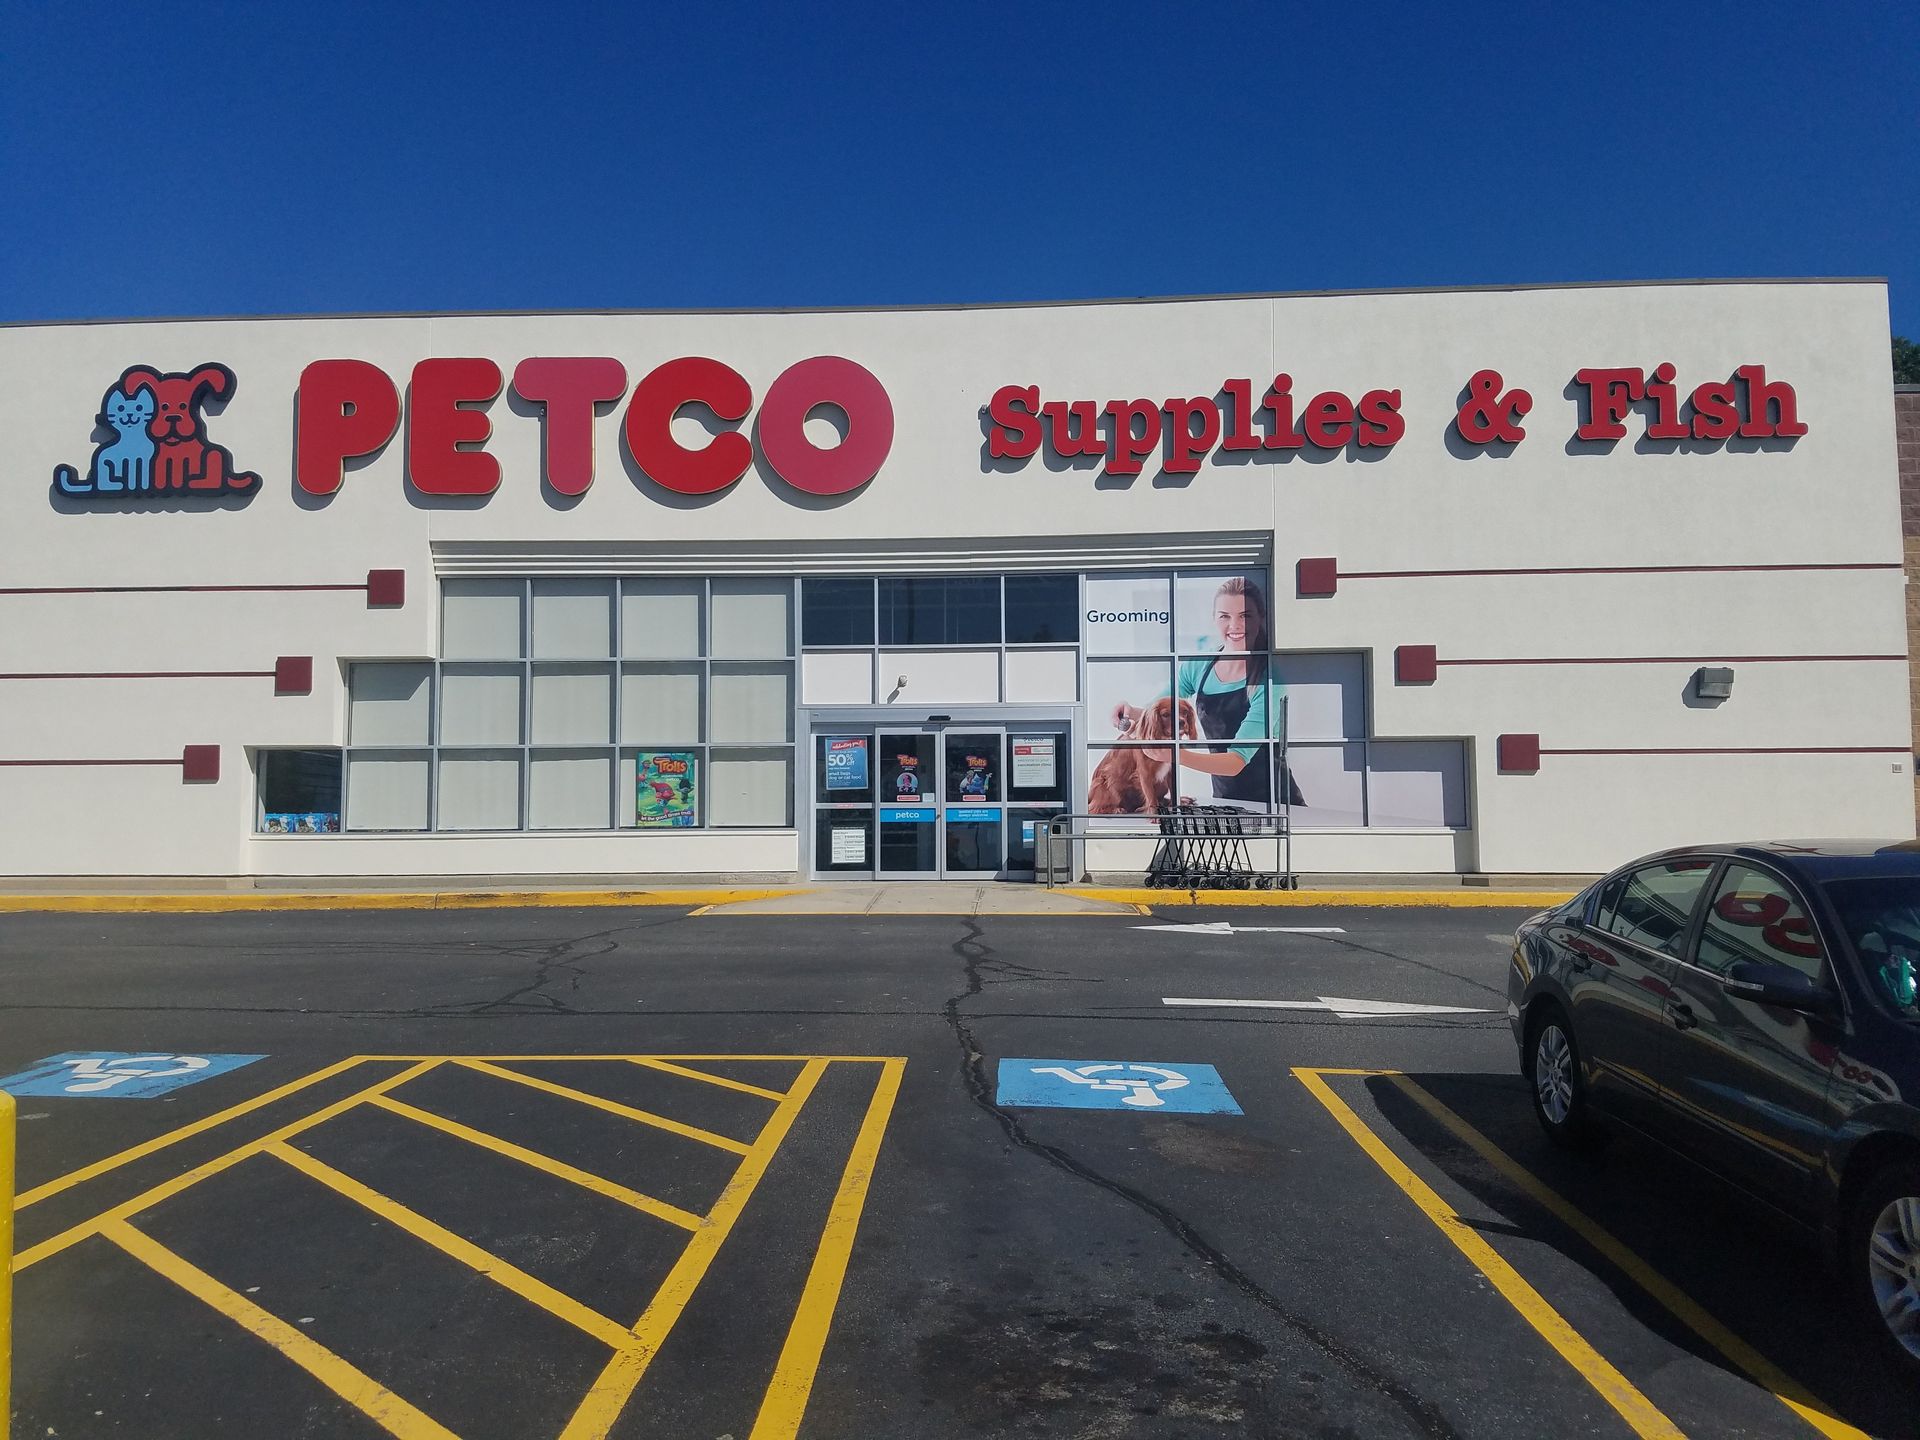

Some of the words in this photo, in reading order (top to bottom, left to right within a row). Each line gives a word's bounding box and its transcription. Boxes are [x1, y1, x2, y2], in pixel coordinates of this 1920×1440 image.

[297, 355, 895, 495] PETCO
[989, 372, 1406, 475] Supplies
[1457, 369, 1533, 444] &
[1577, 362, 1809, 440] Fish
[1087, 609, 1169, 624] Grooming
[654, 759, 687, 773] Trolls
[897, 757, 918, 766] Trolls
[966, 758, 987, 767] Trolls
[895, 811, 920, 820] petco
